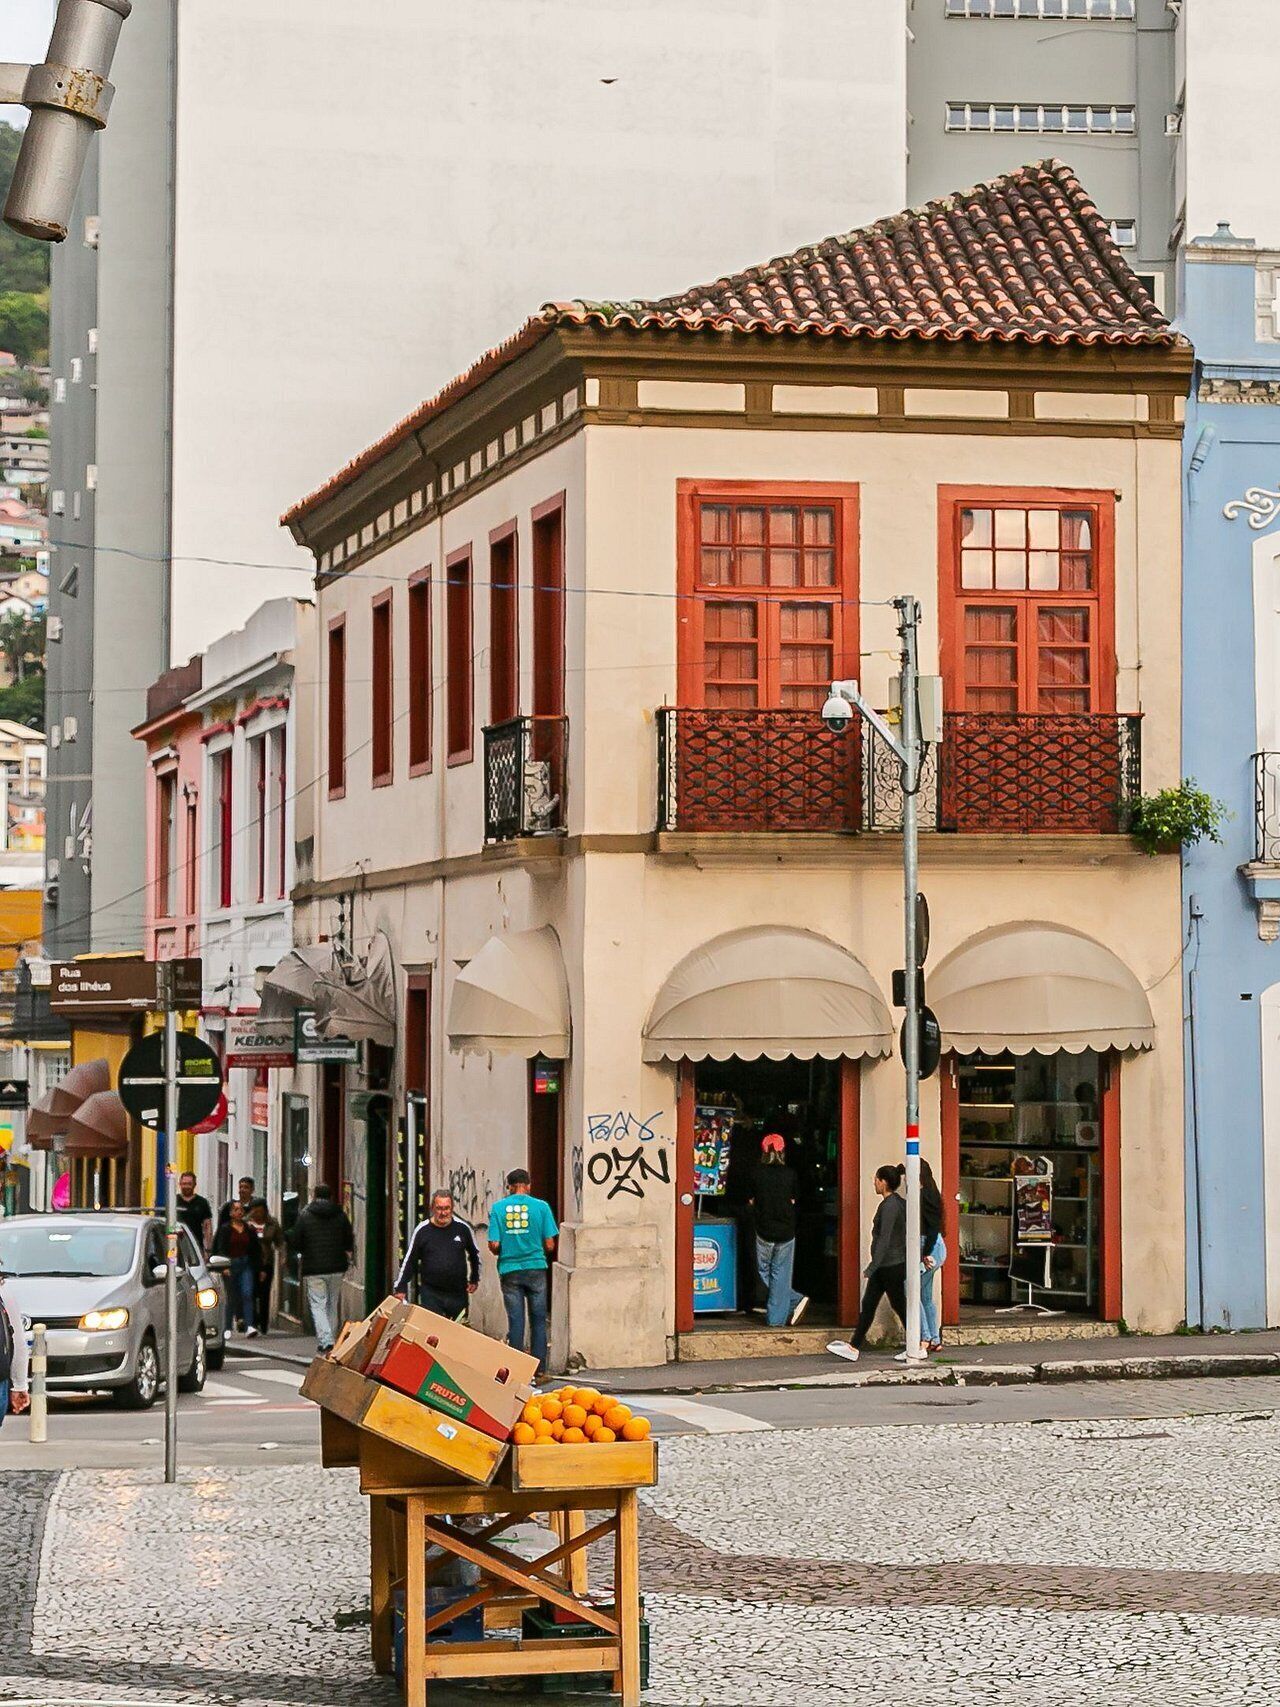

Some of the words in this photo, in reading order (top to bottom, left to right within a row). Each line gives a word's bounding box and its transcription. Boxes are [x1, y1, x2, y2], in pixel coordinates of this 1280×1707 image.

[60, 967, 81, 978] Rua
[58, 981, 79, 992] dos
[80, 980, 112, 991] Ilhéus
[430, 1382, 467, 1406] FRUTAS
